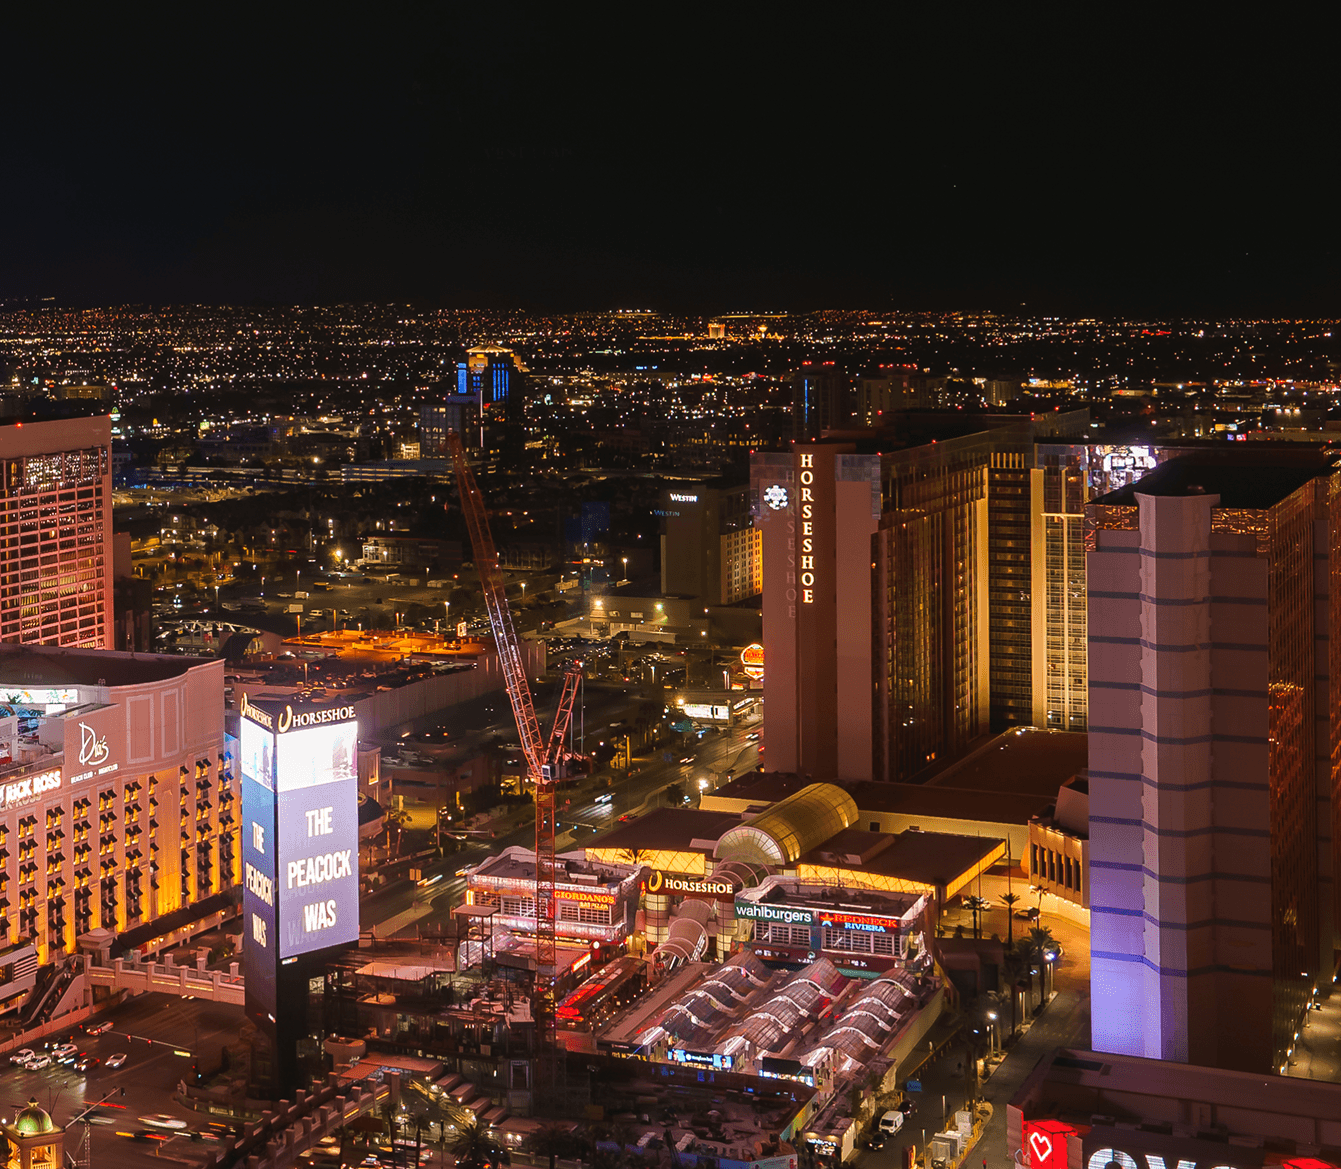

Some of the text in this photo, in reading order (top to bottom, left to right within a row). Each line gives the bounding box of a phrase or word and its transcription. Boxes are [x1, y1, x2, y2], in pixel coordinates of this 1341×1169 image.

[670, 494, 698, 502] WESTIN
[800, 454, 814, 603] HORSESHOE
[292, 706, 356, 727] HORSESHOE
[33, 770, 62, 793] ROSS
[305, 806, 334, 838] THE
[252, 821, 265, 854] THE
[287, 849, 352, 890] PEACOCK
[245, 861, 273, 908] PEACOCK
[664, 878, 734, 894] HORSESHOE
[554, 890, 615, 904] GIORDANO'S
[304, 899, 337, 933] WAS
[736, 906, 812, 923] wahlburgers
[833, 913, 897, 928] REDNECK
[252, 912, 267, 948] WAS
[844, 922, 886, 933] RIVIERA
